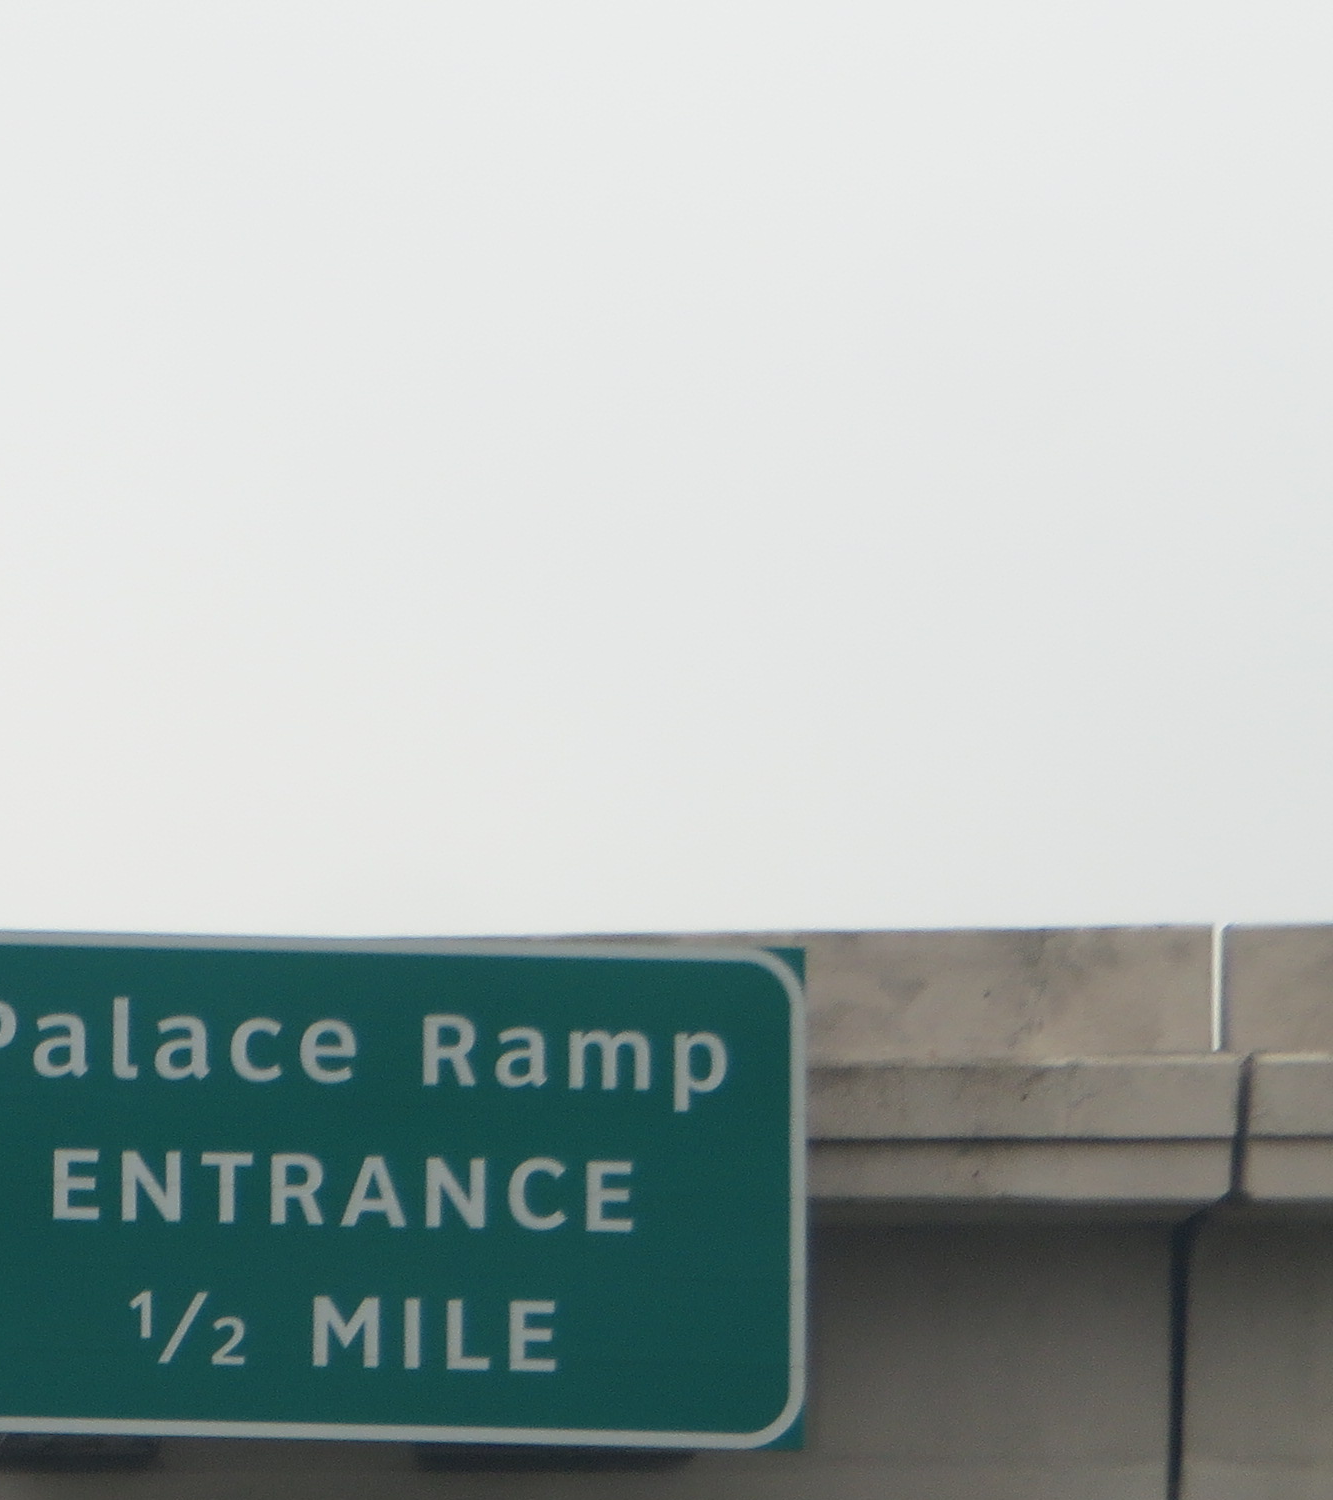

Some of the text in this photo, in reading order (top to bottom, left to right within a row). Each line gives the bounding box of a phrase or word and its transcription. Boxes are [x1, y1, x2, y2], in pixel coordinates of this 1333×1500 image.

[422, 1013, 729, 1112] Ramp
[52, 1148, 635, 1232] ENTRANCE
[129, 1290, 558, 1373] 1/2 MILE
